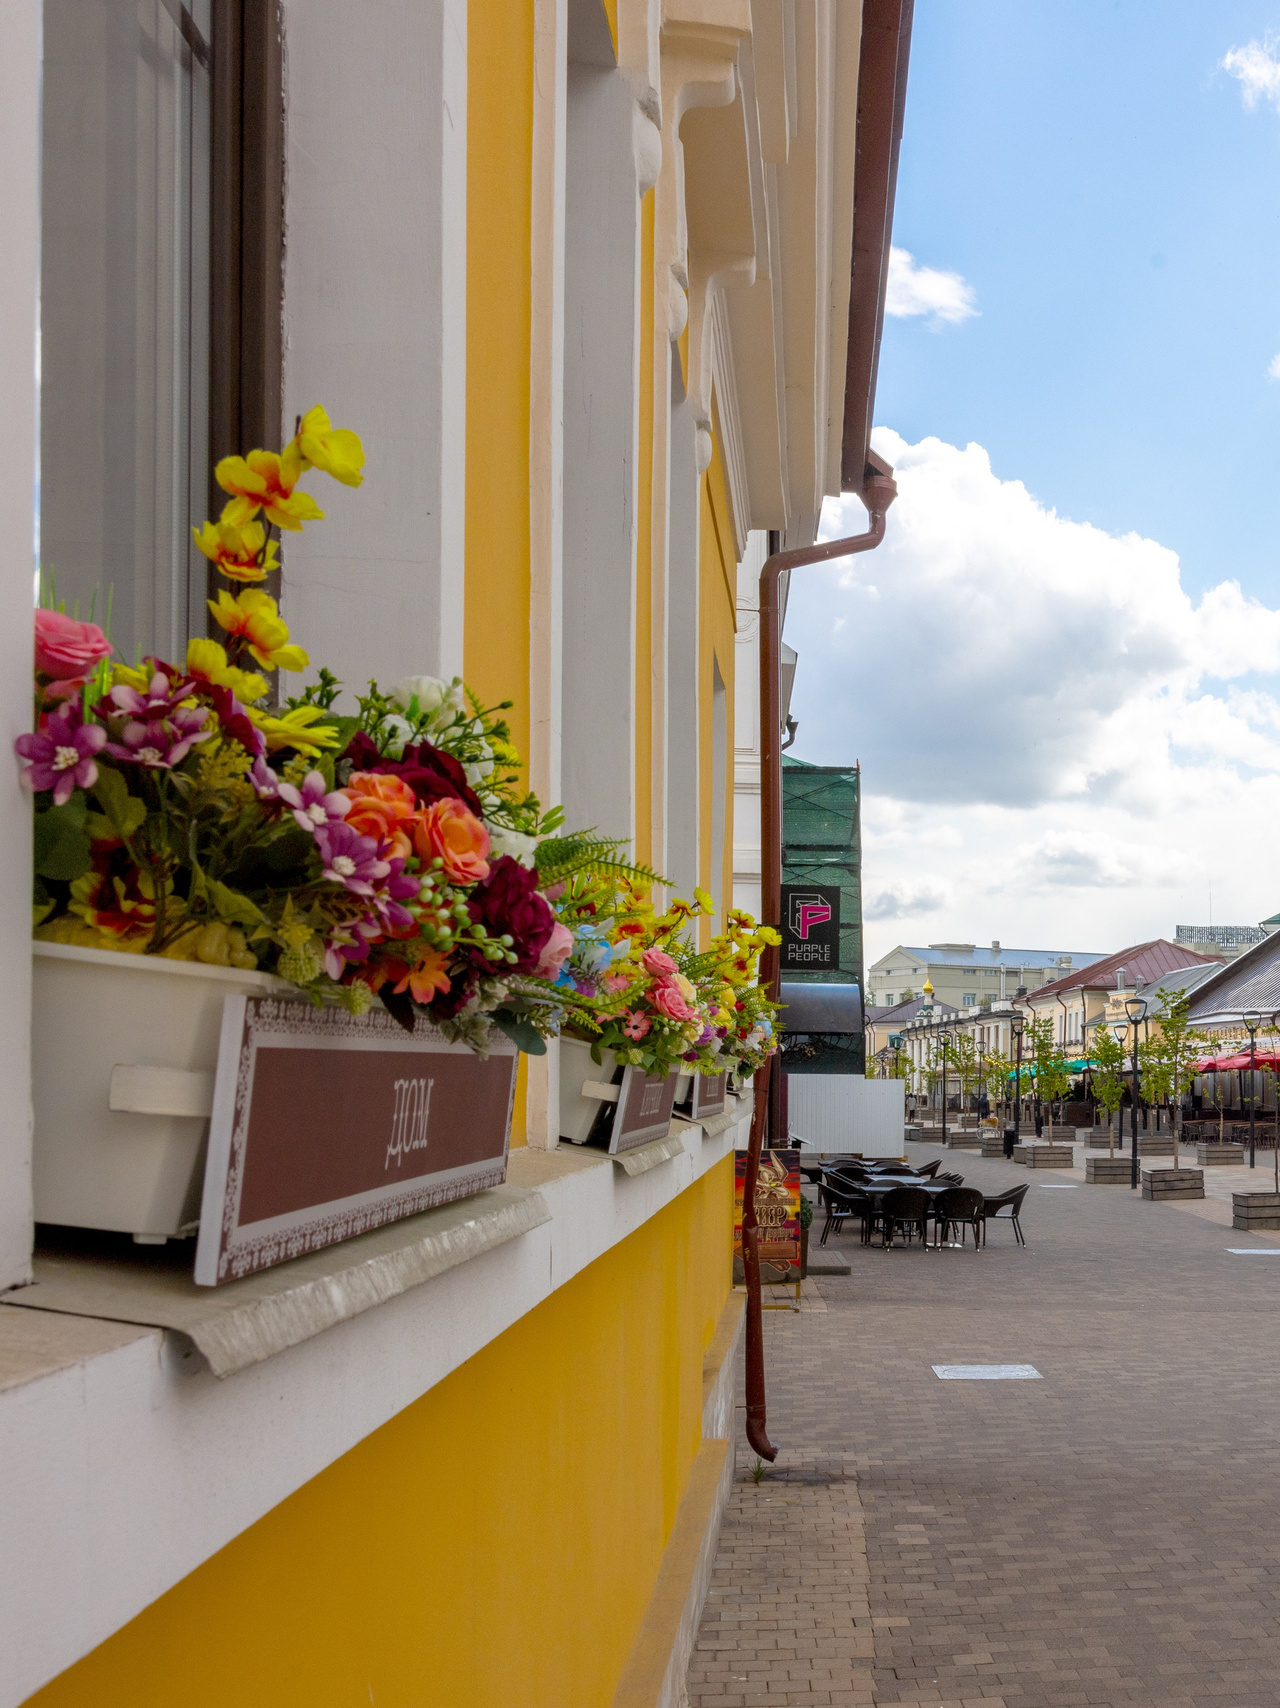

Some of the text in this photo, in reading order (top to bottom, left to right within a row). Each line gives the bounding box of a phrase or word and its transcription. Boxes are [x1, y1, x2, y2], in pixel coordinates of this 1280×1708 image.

[788, 943, 831, 953] PURPLE
[788, 953, 831, 962] PEOPLE
[743, 1205, 786, 1227] ИР
